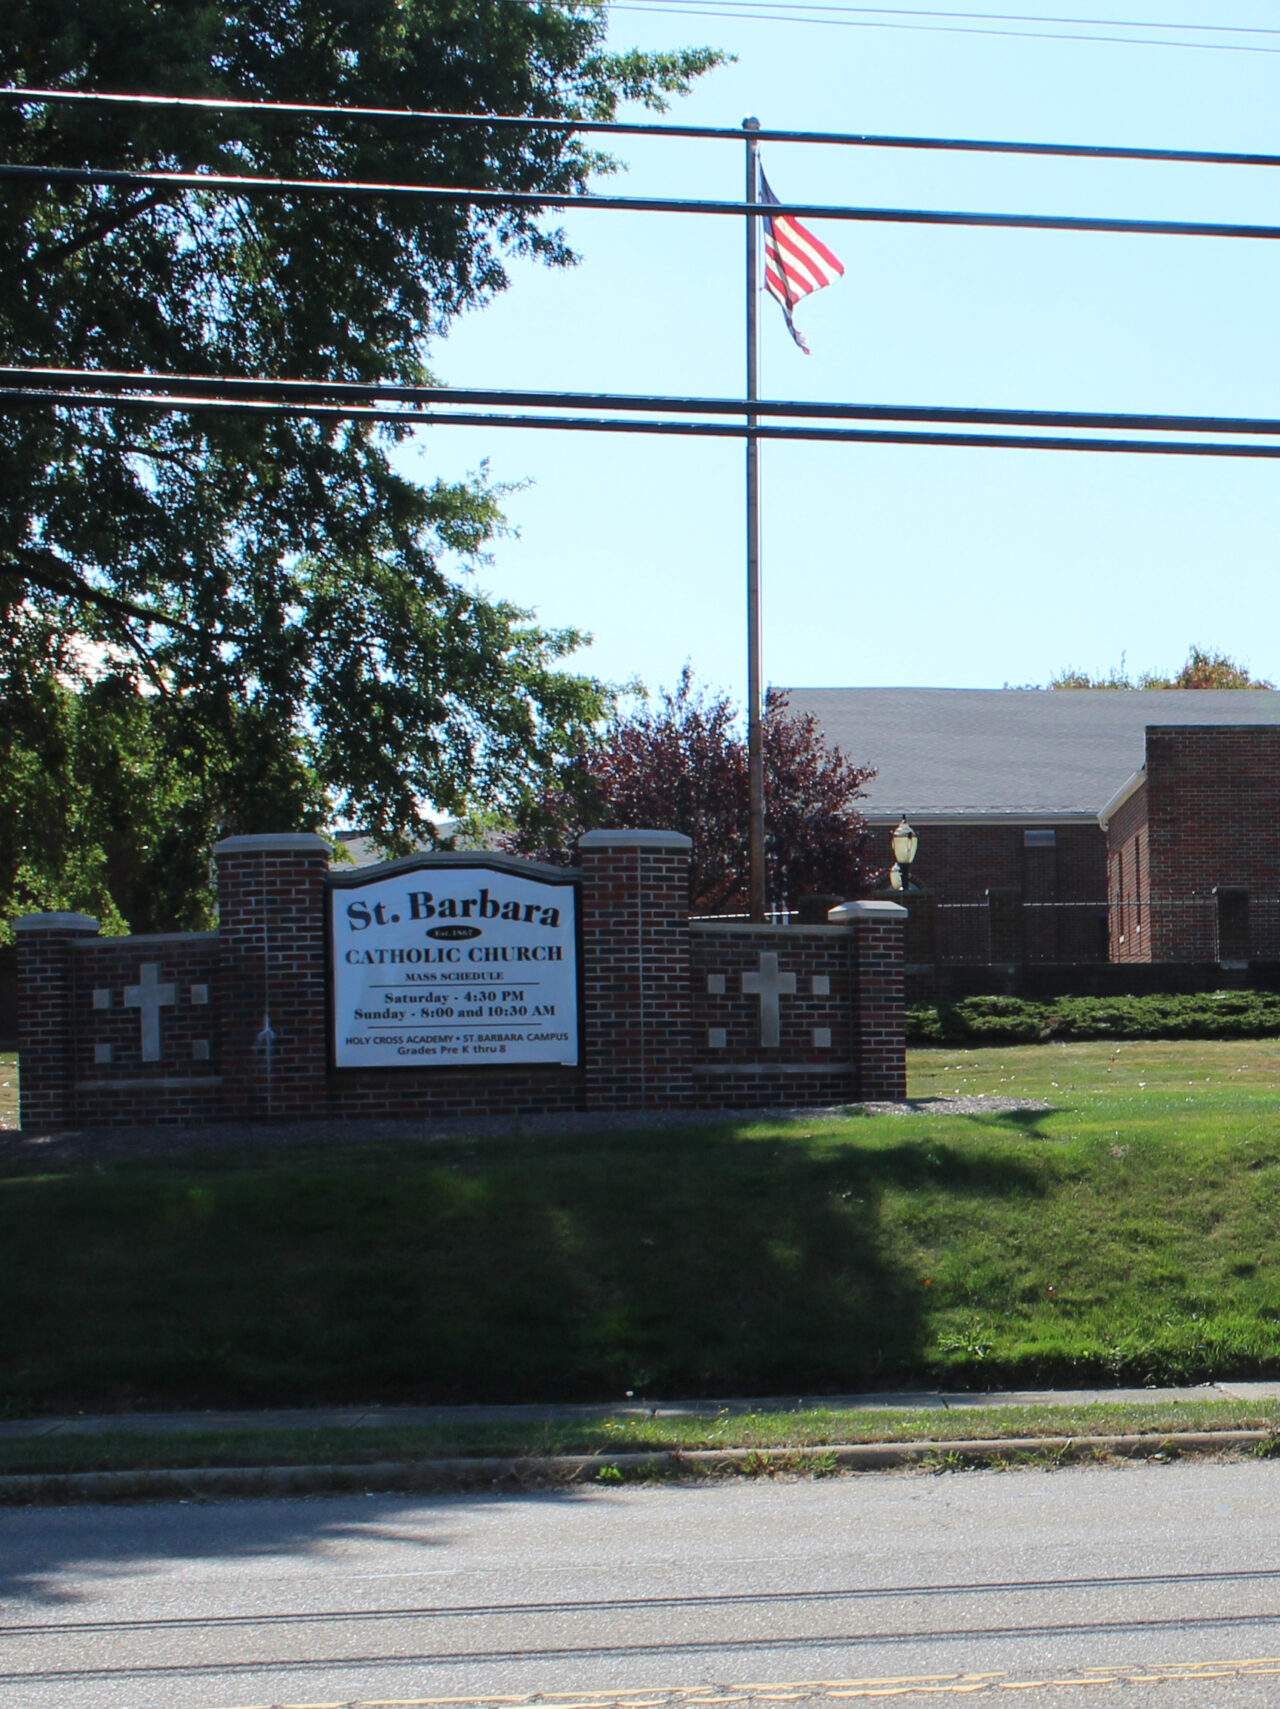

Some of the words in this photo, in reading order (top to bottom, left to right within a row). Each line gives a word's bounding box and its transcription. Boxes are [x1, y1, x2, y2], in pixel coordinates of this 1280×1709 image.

[347, 900, 400, 932] St.
[408, 888, 560, 927] Barbara
[346, 948, 460, 964] CATHOLIC
[468, 946, 563, 962] CHURCH
[405, 973, 437, 982] MASS
[440, 972, 504, 981] SCHEDULE
[385, 992, 449, 1005] Saturday
[464, 991, 496, 1002] 4:30
[502, 991, 524, 1002] PM
[354, 1008, 406, 1021] Sunday
[421, 1007, 454, 1018] 8:00
[457, 1006, 484, 1018] and
[488, 1006, 528, 1017] 10:30
[532, 1005, 555, 1016] AM
[346, 1037, 371, 1045] HOLY
[373, 1036, 404, 1044] CROSS
[406, 1035, 453, 1044] ACADEMY
[478, 1033, 523, 1042] BARBARA
[527, 1032, 569, 1042] CAMPUS
[397, 1046, 437, 1055] Grades
[441, 1046, 458, 1054] Pre
[463, 1045, 469, 1054] K
[474, 1045, 497, 1054] thru
[499, 1045, 506, 1053] 8
